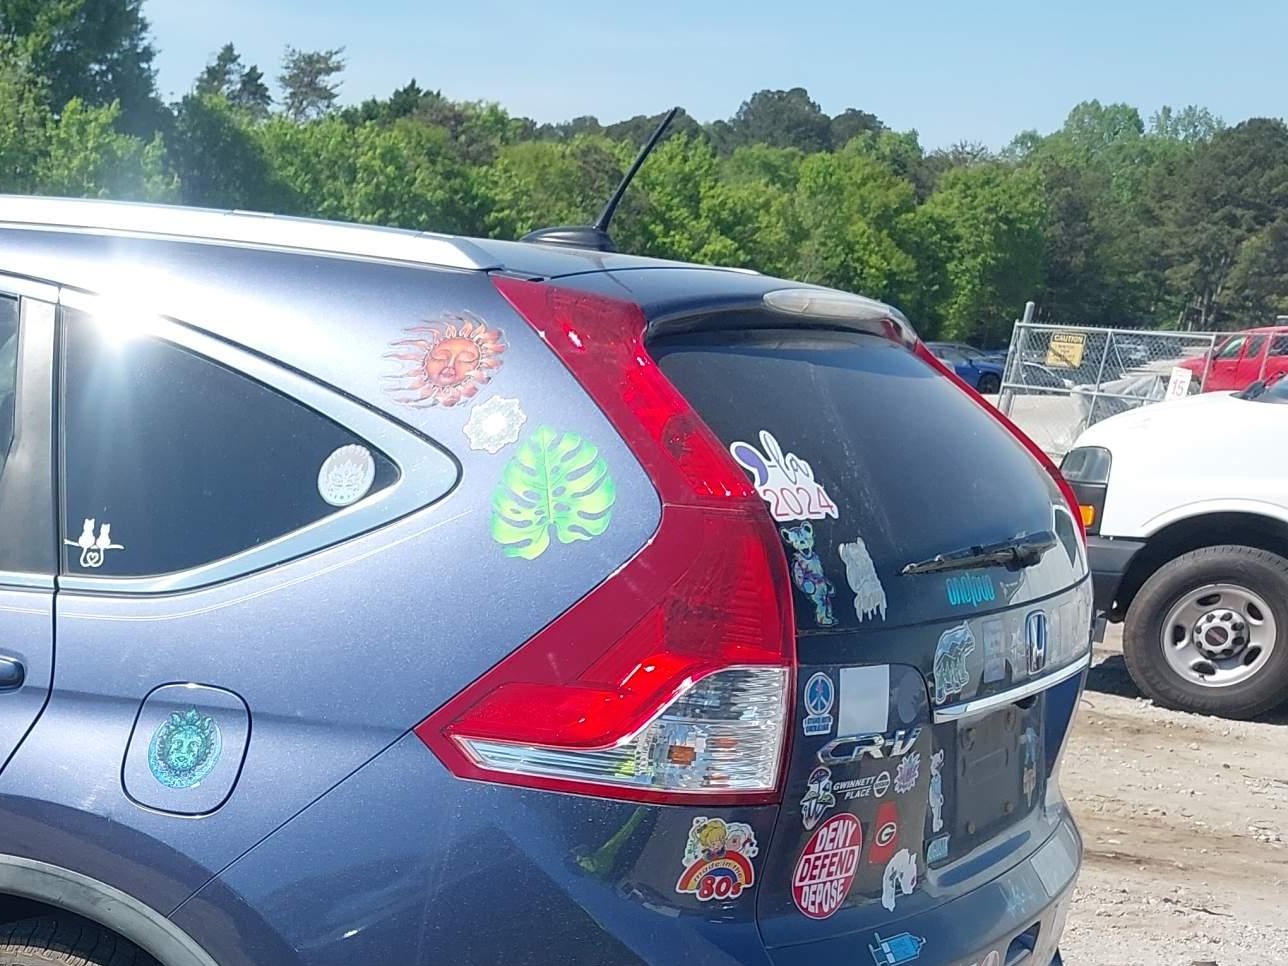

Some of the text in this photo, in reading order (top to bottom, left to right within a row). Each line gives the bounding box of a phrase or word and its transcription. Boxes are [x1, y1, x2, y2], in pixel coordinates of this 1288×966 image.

[1172, 379, 1186, 396] 15
[763, 487, 835, 517] 2024
[817, 727, 922, 765] CR-V
[832, 776, 876, 791] GWINNETT
[844, 788, 872, 800] PLACE
[814, 819, 857, 853] DENY
[798, 847, 855, 884] DEFEND
[698, 875, 742, 899] 80s
[802, 878, 845, 914] DEPOSE
